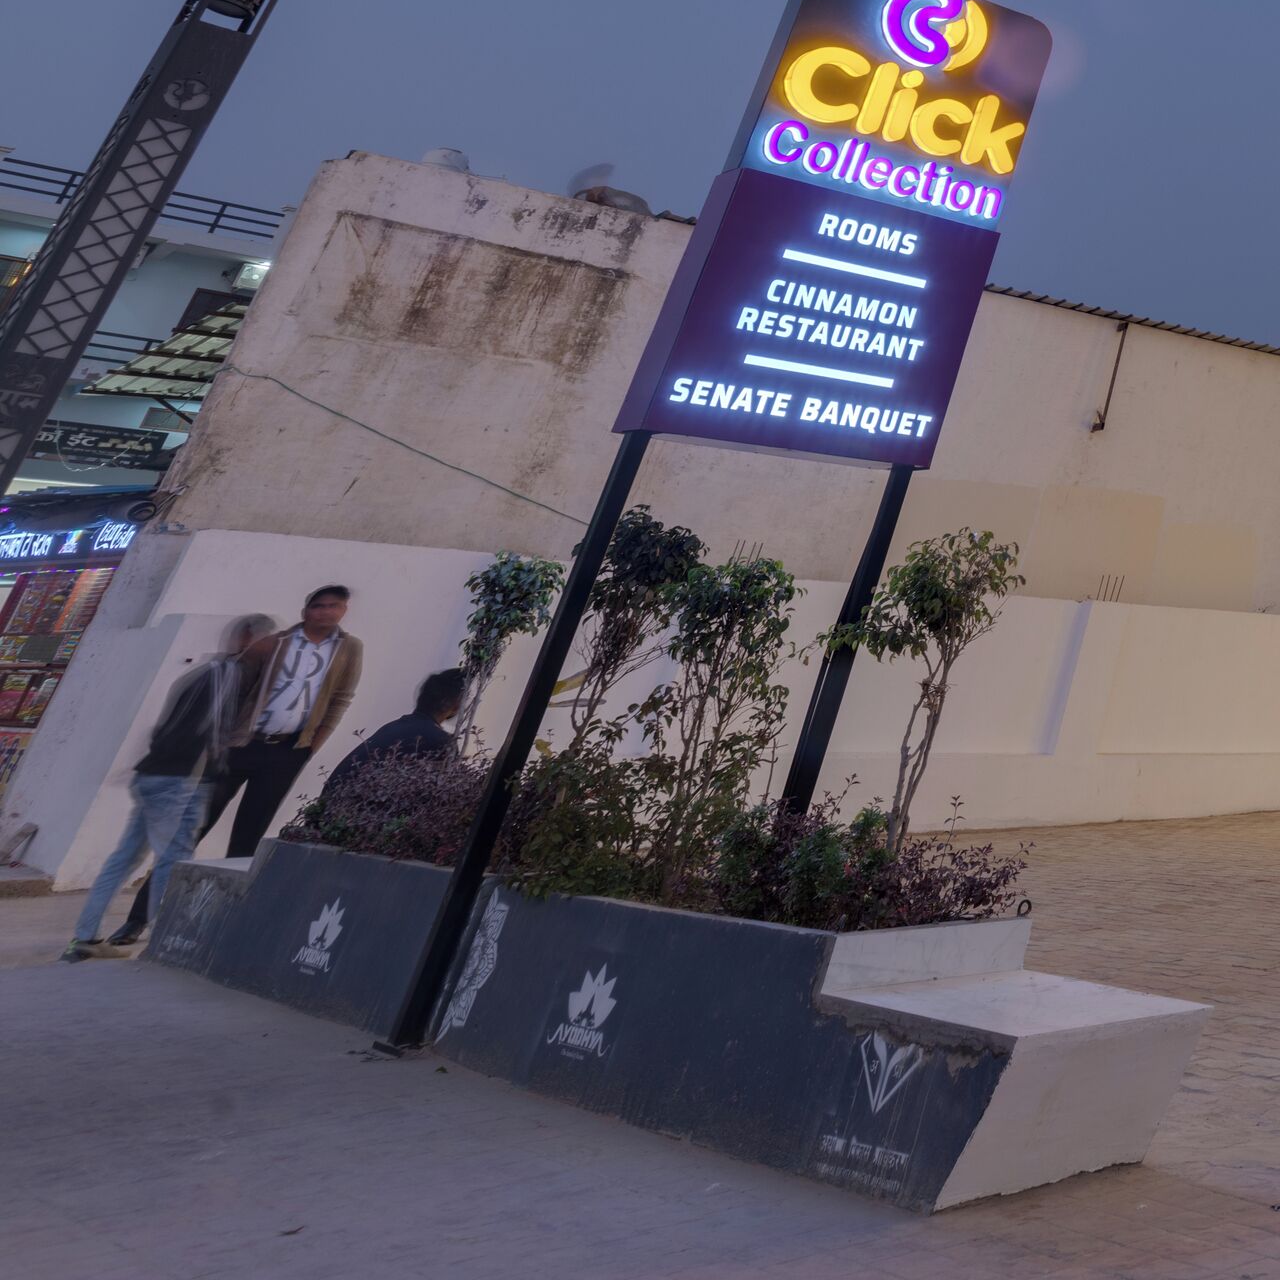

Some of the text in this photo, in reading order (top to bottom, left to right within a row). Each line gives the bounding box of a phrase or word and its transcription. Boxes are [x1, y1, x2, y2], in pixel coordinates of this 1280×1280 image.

[783, 46, 1026, 176] Click
[762, 118, 1003, 221] Collection
[817, 213, 918, 256] ROOMS
[766, 279, 917, 329] CINNAMON
[736, 306, 924, 362] RESTAURANT
[669, 377, 933, 438] SENATE BANQUET
[547, 1022, 611, 1057] AYODHYA
